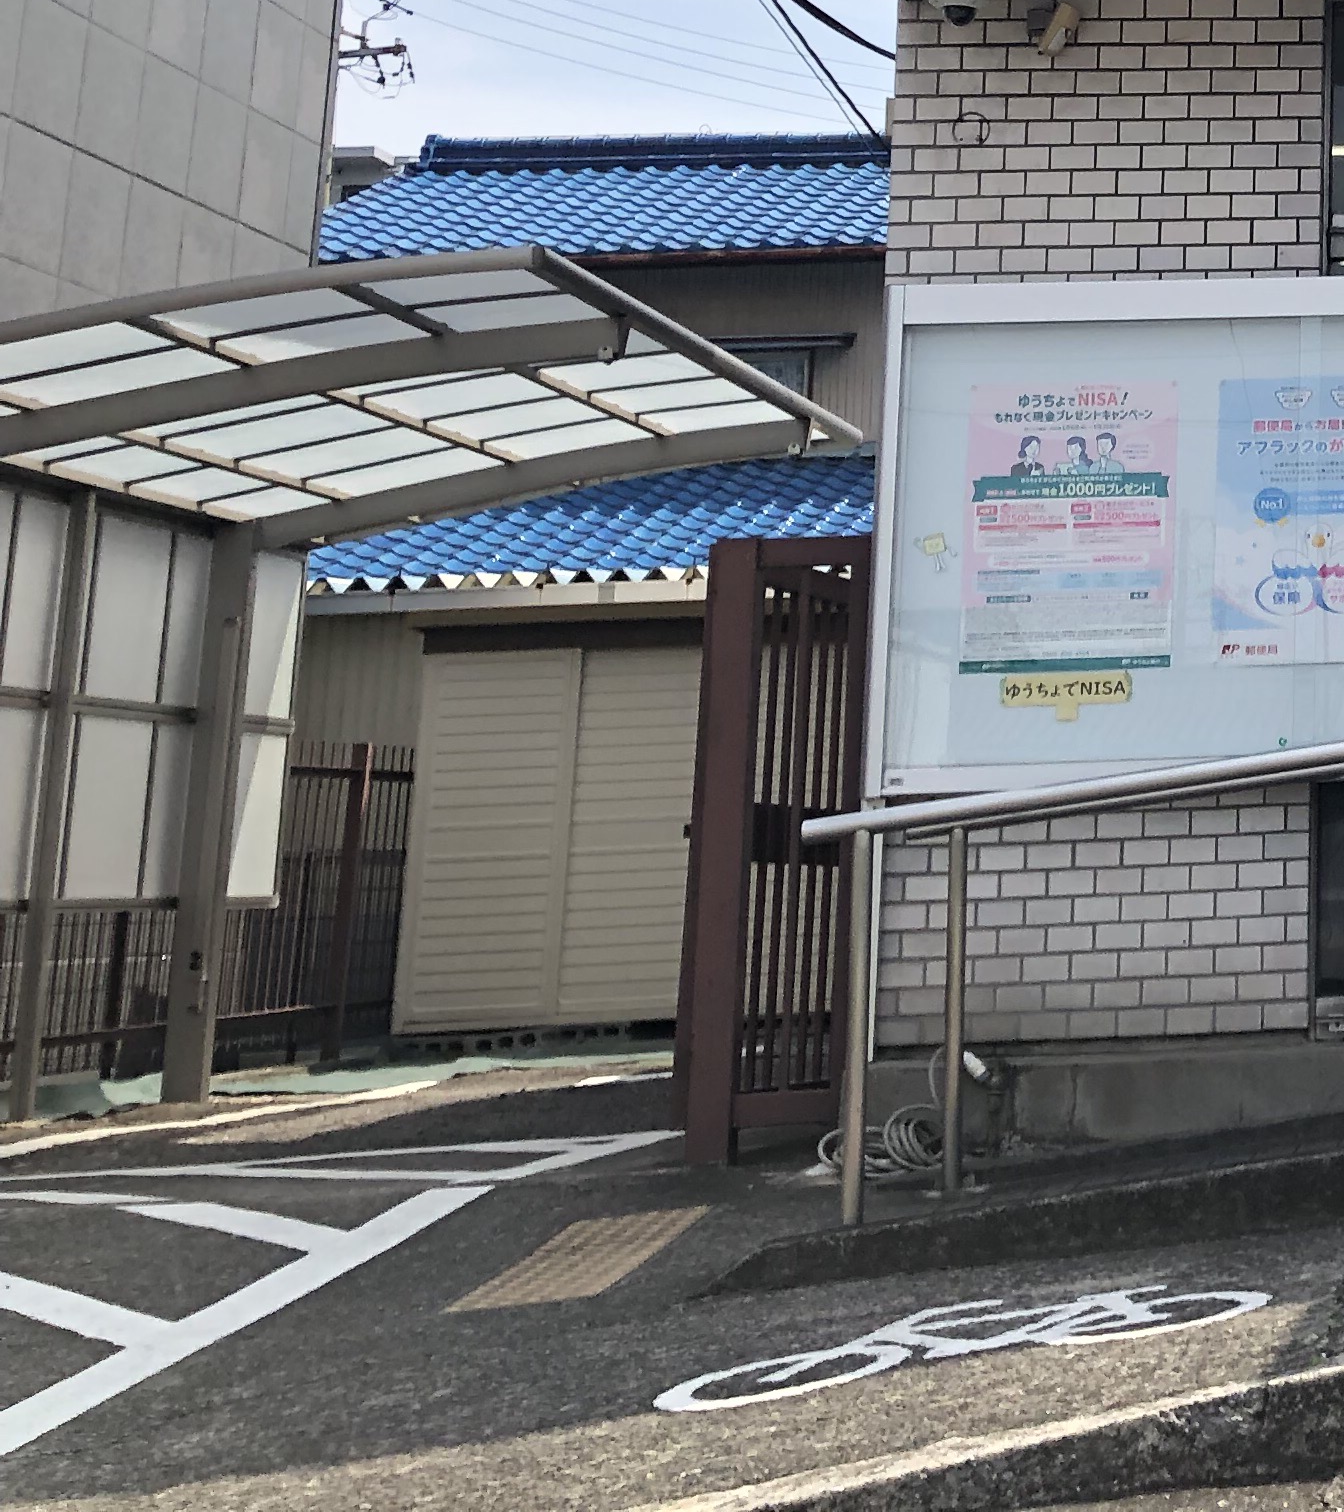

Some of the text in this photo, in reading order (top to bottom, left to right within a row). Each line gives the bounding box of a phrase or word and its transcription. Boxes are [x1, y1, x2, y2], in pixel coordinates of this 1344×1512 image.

[1005, 679, 1127, 700] ゆうちょでNISA
